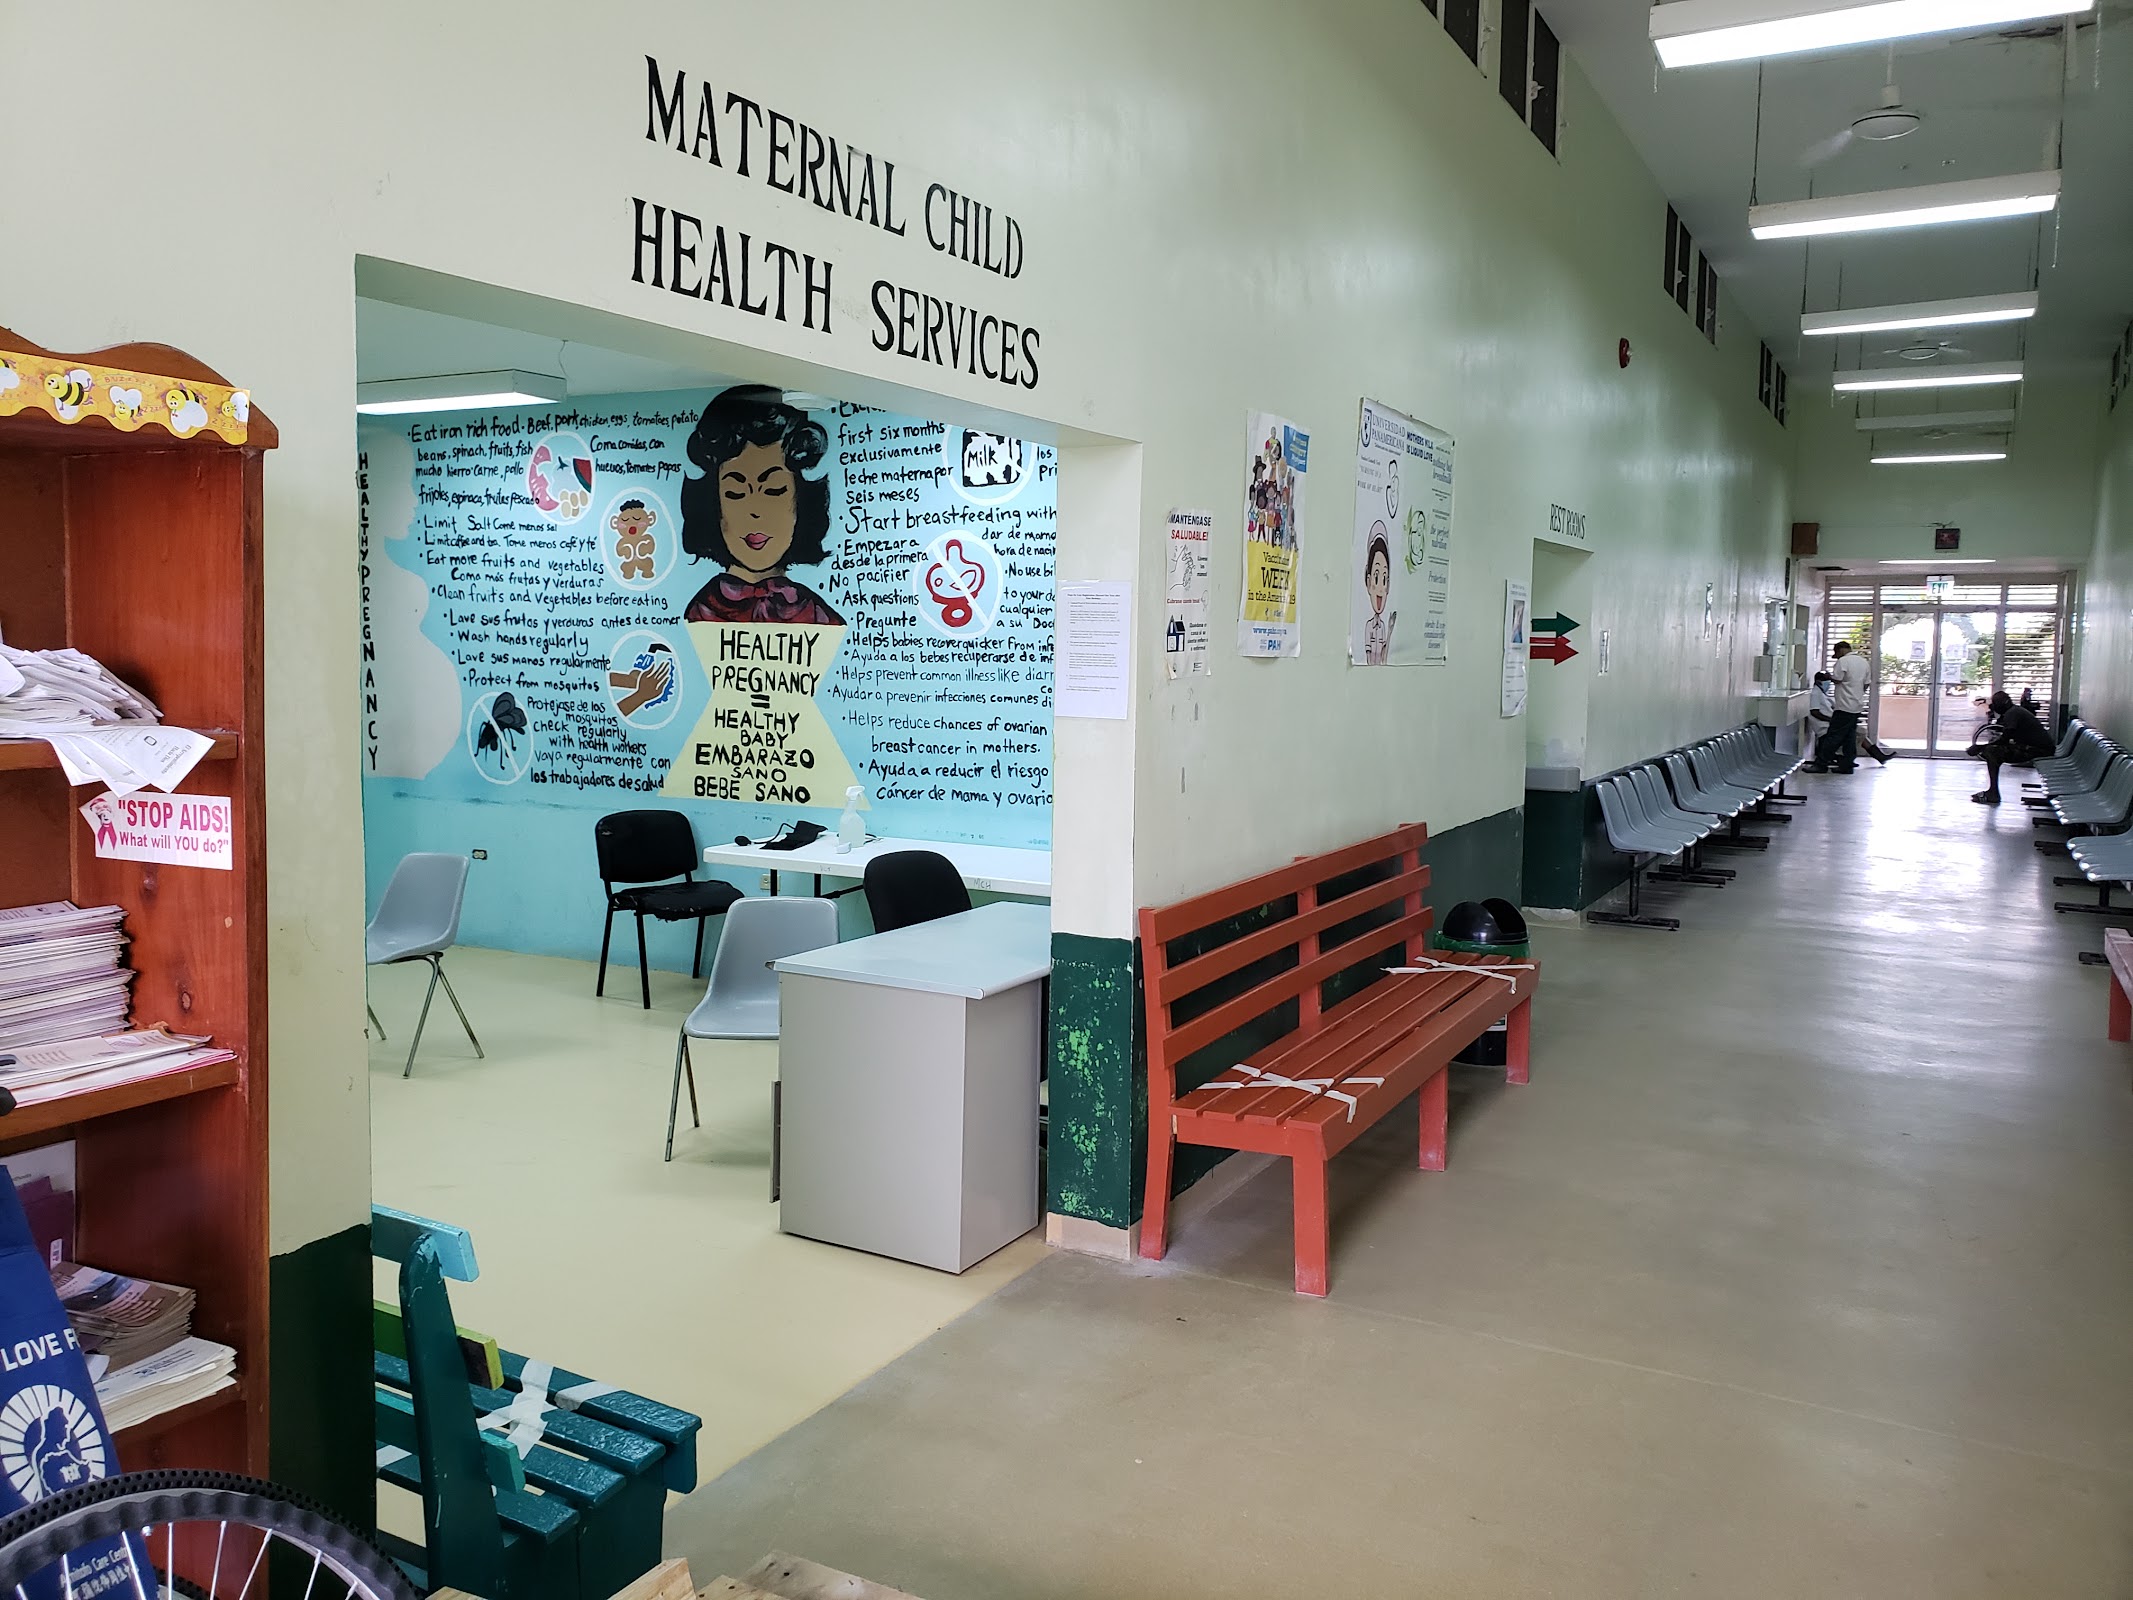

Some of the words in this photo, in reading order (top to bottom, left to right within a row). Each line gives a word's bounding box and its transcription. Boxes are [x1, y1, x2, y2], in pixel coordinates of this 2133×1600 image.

[645, 54, 906, 237] MATERNAL
[924, 183, 1023, 279] CHILD
[631, 197, 833, 334] HEALTH
[871, 280, 1040, 389] SERVICES
[411, 424, 437, 442] Eat
[440, 424, 462, 439] iron
[466, 417, 488, 438] rich
[838, 423, 873, 447] first
[880, 425, 901, 441] six
[903, 420, 945, 438] months
[839, 443, 943, 465] exclusivamente
[967, 444, 999, 468] Milk
[1036, 446, 1052, 461] los
[844, 467, 877, 487] leche
[881, 466, 933, 483] materna
[933, 465, 954, 488] por
[846, 490, 875, 505] seis
[879, 487, 920, 502] meses
[424, 515, 457, 534] Limit
[845, 506, 901, 534] Start
[906, 504, 1022, 529] breastfeeding
[1027, 505, 1058, 520] with
[1550, 503, 1567, 534] REST
[1566, 509, 1586, 540] ROOMS
[424, 530, 450, 547] Limit
[579, 537, 586, 549] y
[982, 527, 1003, 540] dar
[1007, 526, 1021, 540] de
[844, 539, 907, 557] Empezar
[912, 539, 920, 547] a
[993, 543, 1016, 557] hora
[1018, 542, 1031, 556] de
[426, 550, 447, 565] Eat
[449, 554, 478, 565] more
[481, 552, 515, 569] fruits
[520, 558, 540, 569] and
[548, 557, 605, 577] vegetables
[831, 554, 870, 571] desde
[874, 553, 884, 566] la
[886, 551, 929, 570] primera
[1008, 561, 1024, 578] No
[451, 566, 482, 582] Coma
[508, 572, 541, 587] frutas
[542, 576, 550, 590] y
[550, 575, 603, 589] verduras
[829, 573, 849, 593] No
[857, 568, 910, 590] pacifier
[437, 584, 466, 601] Clean
[467, 583, 504, 603] fruits
[510, 588, 532, 603] and
[596, 593, 629, 606] before
[631, 594, 668, 610] eating
[842, 590, 869, 606] Ask
[870, 588, 920, 611] questions
[1003, 586, 1018, 600] to
[1019, 590, 1045, 605] your
[449, 608, 476, 626] Lave
[480, 612, 500, 625] sus
[503, 609, 539, 629] frutas
[543, 617, 551, 635] y
[551, 616, 594, 628] verduras
[601, 612, 632, 628] antes
[634, 610, 649, 625] de
[651, 615, 681, 625] comer
[856, 610, 917, 636] Pregunte
[996, 620, 1005, 628] a
[1009, 619, 1023, 628] su
[457, 629, 490, 643] Wash
[496, 632, 528, 646] hands
[529, 631, 589, 656] regularly
[720, 628, 820, 667] HEALTHY
[852, 631, 890, 652] Helps
[892, 630, 924, 648] babies
[457, 649, 485, 664] Lave
[491, 652, 510, 664] sus
[550, 653, 612, 675] regularmente
[851, 649, 887, 667] Ayuda
[902, 651, 915, 662] los
[920, 651, 949, 663] bebes
[951, 651, 1016, 668] recuperarse
[1019, 651, 1037, 663] de
[468, 668, 512, 687] Protect
[515, 671, 539, 688] from
[544, 677, 600, 694] mosquitos
[712, 665, 820, 698] PREGNANCY
[841, 665, 873, 686] Helps
[875, 664, 918, 686] prevent
[920, 669, 961, 681] common
[965, 667, 996, 681] illness
[832, 685, 873, 702] Ayudar
[875, 691, 883, 700] a
[886, 692, 932, 706] prevenir
[935, 688, 986, 704] infecciones
[990, 693, 1039, 705] comunes
[566, 713, 618, 727] mosquitos
[714, 707, 800, 734] HEALTHY
[848, 710, 884, 728] Helps
[888, 715, 931, 729] reduce
[933, 716, 983, 731] chances
[986, 716, 1002, 731] of
[1004, 719, 1048, 737] ovarian
[549, 734, 575, 749] with
[577, 725, 627, 742] regularly
[740, 730, 789, 749] BABY
[695, 743, 815, 769] EMBARAZO
[871, 736, 915, 753] breast
[917, 741, 961, 755] cancer
[966, 740, 977, 754] in
[566, 753, 644, 770] regularmente
[650, 757, 671, 770] con
[549, 768, 616, 790] trabajadores
[618, 772, 632, 789] de
[730, 766, 787, 783] SANO
[868, 759, 918, 781] Ayuda
[920, 766, 931, 776] a
[935, 761, 984, 779] reducir
[991, 759, 1001, 779] el
[1007, 763, 1049, 788] riesgo
[694, 775, 740, 800] BEBE
[755, 782, 811, 804] SANO
[876, 782, 925, 801] cáncer
[928, 784, 945, 801] de
[951, 790, 989, 802] mama
[993, 791, 1002, 808] y
[118, 799, 173, 830] "STOP
[180, 803, 229, 834] AIDS!
[119, 831, 148, 848] What
[150, 834, 171, 850] will
[174, 835, 199, 851] YOU
[203, 837, 229, 854] do?"
[0, 1332, 64, 1372] LOVE
